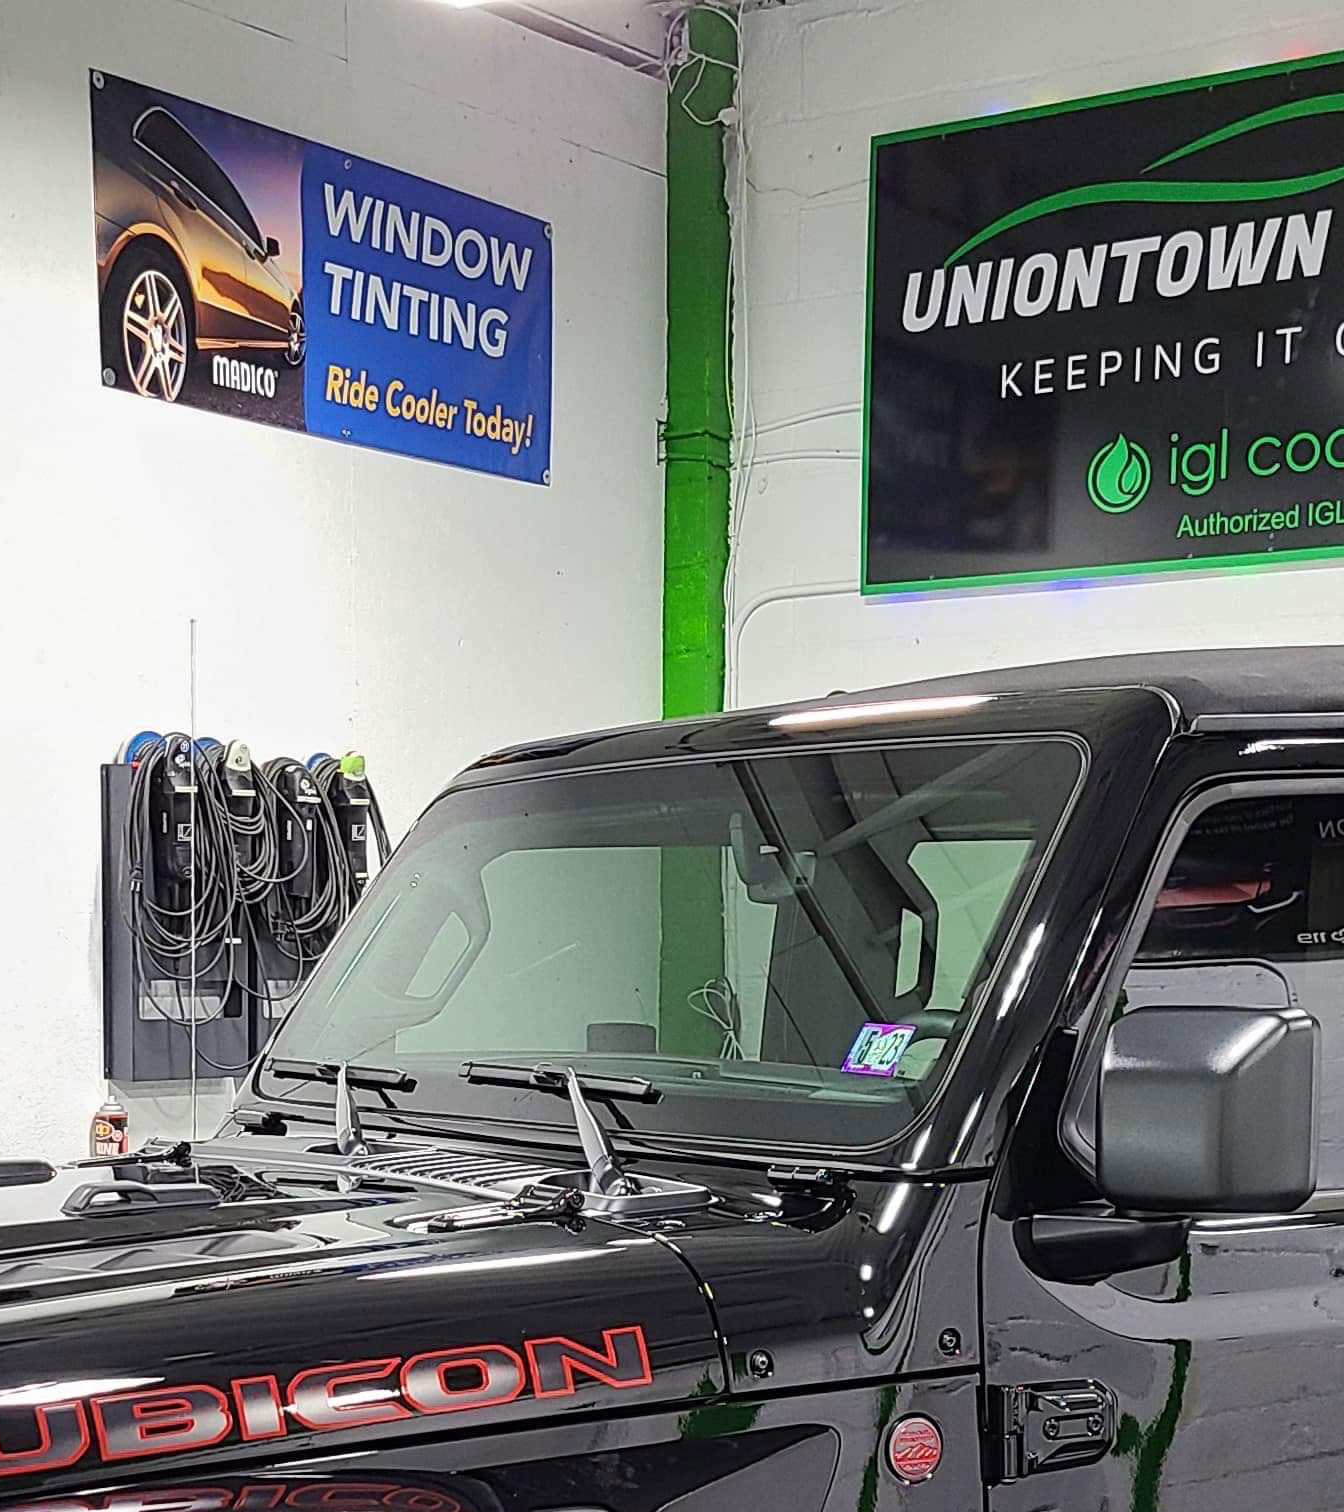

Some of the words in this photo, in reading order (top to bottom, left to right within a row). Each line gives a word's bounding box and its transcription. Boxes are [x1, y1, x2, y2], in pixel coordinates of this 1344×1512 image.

[323, 182, 533, 292] WINDOW
[901, 209, 1332, 334] UNIONTOWN
[323, 262, 510, 359] TINTING
[212, 354, 276, 398] MADICO
[1000, 337, 1221, 399] KEEPING
[1256, 326, 1302, 367] IT
[326, 365, 378, 411] Ride
[385, 380, 458, 430] Cooler
[463, 400, 534, 454] Today!
[1169, 428, 1228, 495] igl
[1176, 504, 1299, 538] Authorized
[878, 1032, 906, 1065] 23
